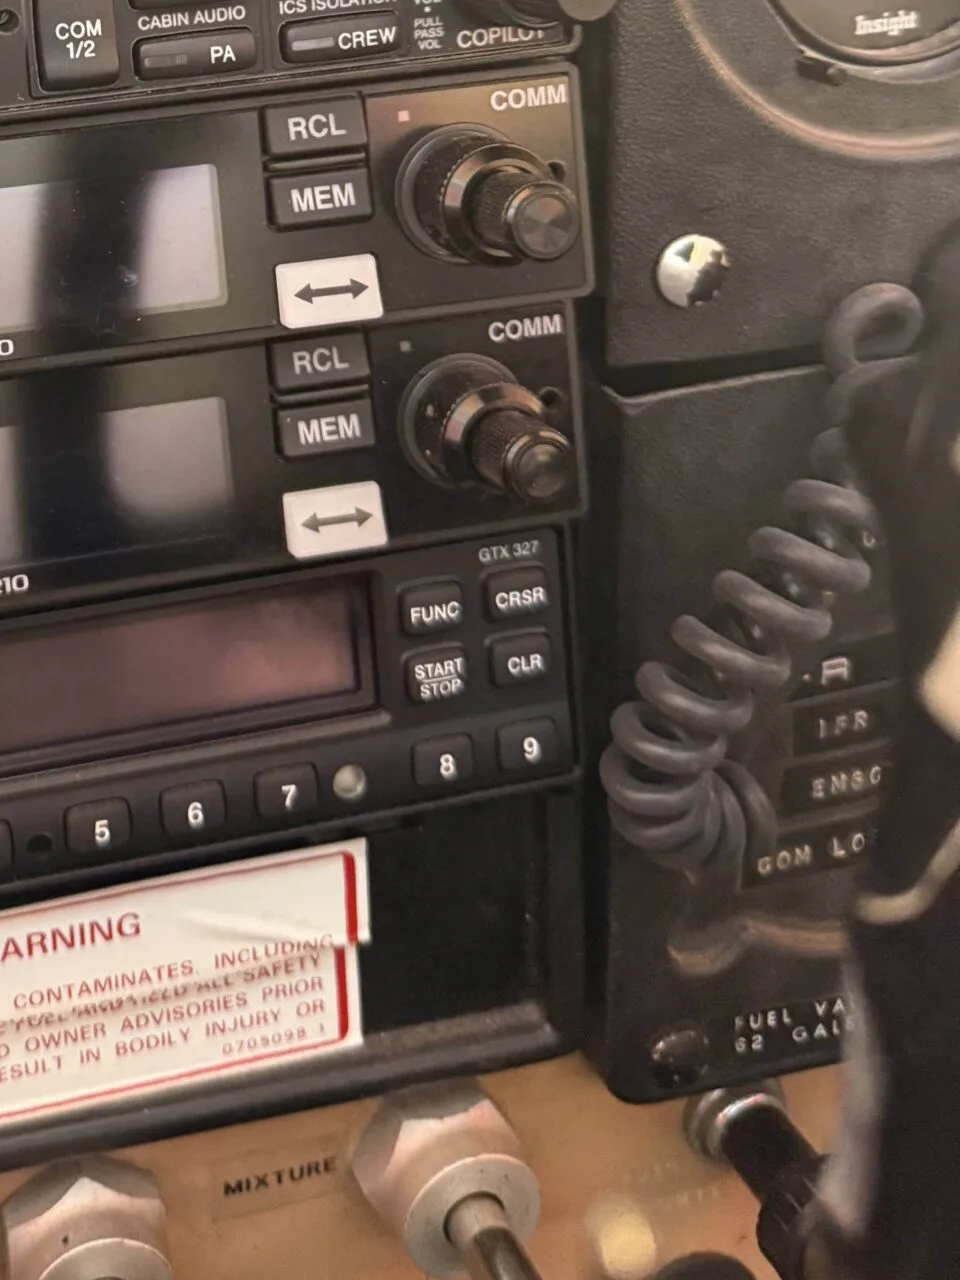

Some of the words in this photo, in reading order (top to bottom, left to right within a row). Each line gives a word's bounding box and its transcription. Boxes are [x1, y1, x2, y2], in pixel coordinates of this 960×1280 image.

[54, 19, 102, 42] COM
[137, 12, 189, 31] CABIN
[194, 5, 246, 24] AUDIO
[854, 9, 918, 36] Insight
[66, 39, 96, 60] 1/2
[337, 26, 397, 51] CREW
[418, 39, 443, 50] VOL
[456, 24, 545, 49] COPILO
[210, 45, 237, 64] PA
[490, 83, 569, 112] COMM
[288, 113, 347, 141] RCL
[290, 182, 356, 213] MEM
[488, 314, 562, 342] COMM
[292, 346, 349, 374] RCL
[297, 414, 360, 445] MEM
[478, 544, 510, 564] GTX
[513, 540, 540, 557] 327
[495, 586, 547, 611] CRSR
[410, 601, 462, 626] FUNC
[414, 657, 465, 680] START
[507, 653, 545, 677] CLR
[420, 678, 464, 701] STOP
[523, 736, 541, 764] 9
[439, 753, 456, 780] 8
[280, 784, 298, 810] 7
[186, 801, 204, 829] 6
[94, 819, 111, 845] 5
[243, 952, 322, 983] SAFETY
[25, 1021, 107, 1053] OWNER
[120, 991, 249, 1033] ADVISORIES
[261, 976, 324, 1002] PRIOR
[735, 1007, 792, 1031] FUEL
[79, 1046, 102, 1065] IN
[115, 1027, 191, 1057] BODILY
[205, 1007, 282, 1038] INJURY
[296, 998, 326, 1018] OR
[223, 1156, 338, 1198] MIXTURE
